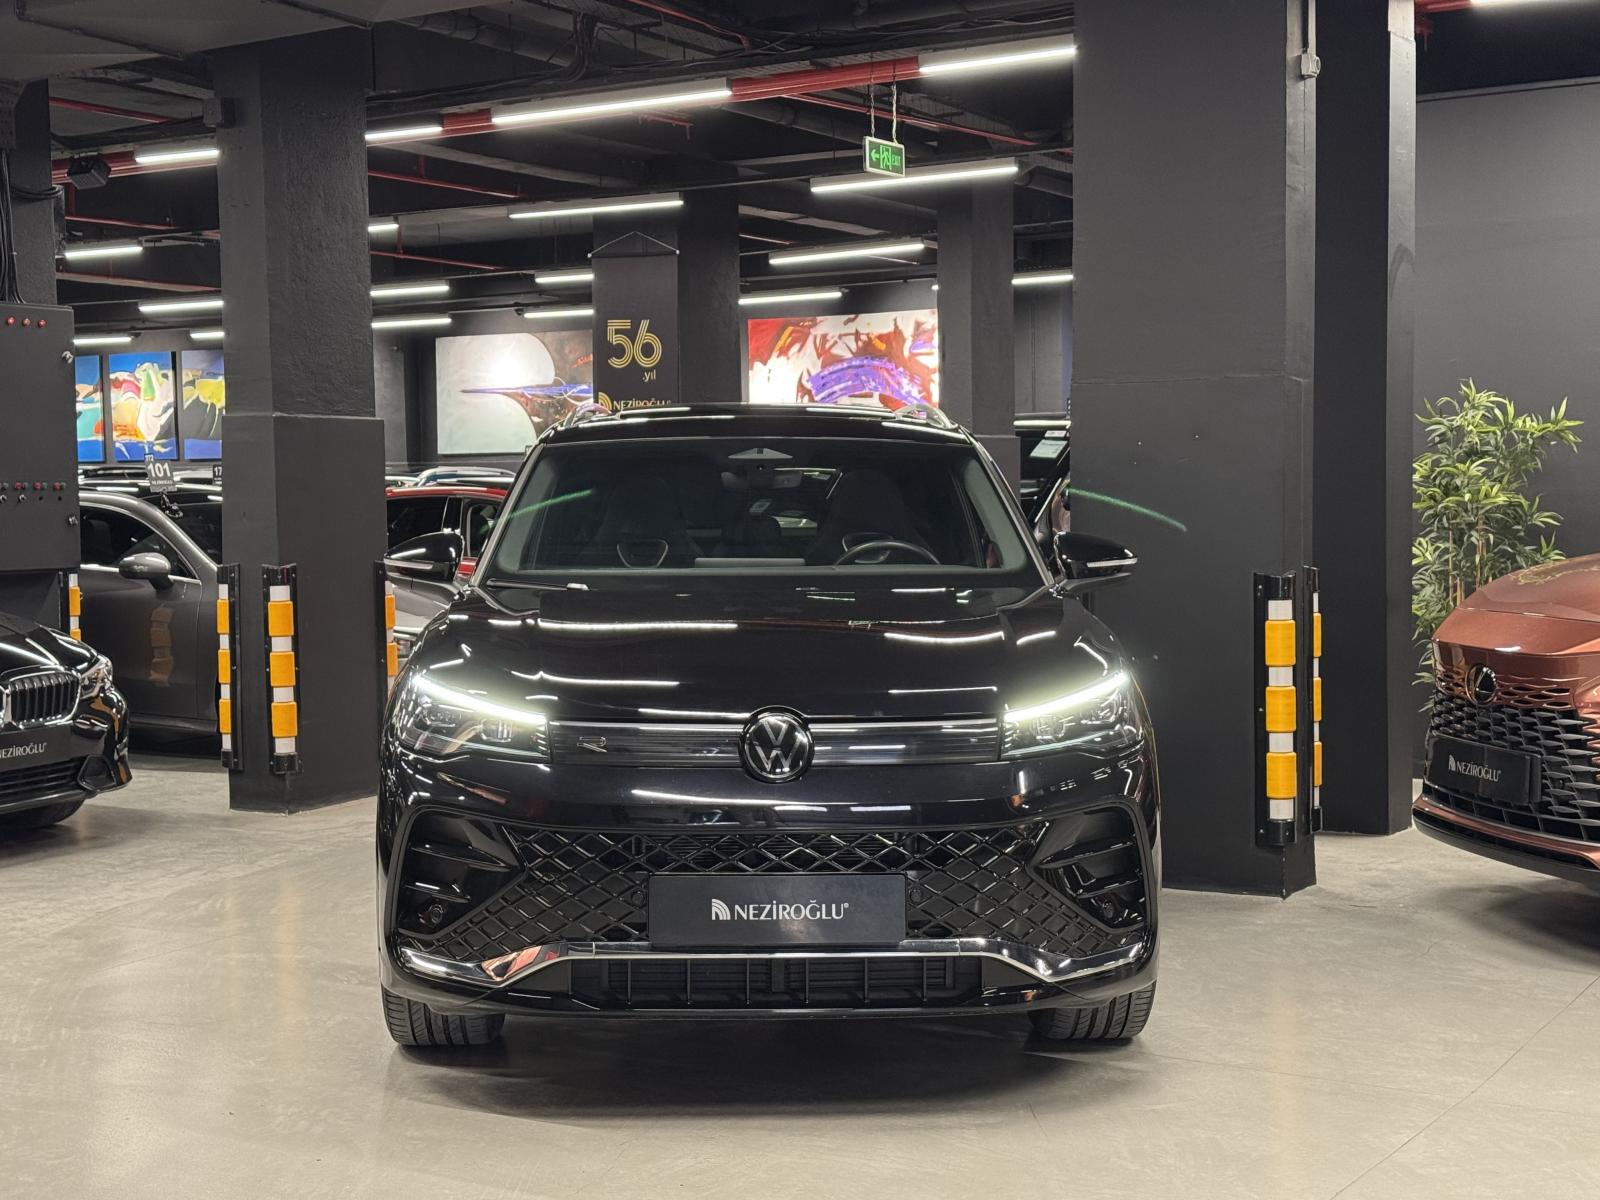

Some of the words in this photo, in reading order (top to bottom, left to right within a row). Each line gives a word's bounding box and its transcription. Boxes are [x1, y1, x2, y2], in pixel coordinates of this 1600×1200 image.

[607, 319, 662, 368] 56
[147, 462, 171, 478] 101
[0, 742, 45, 758] EZİROĞLU
